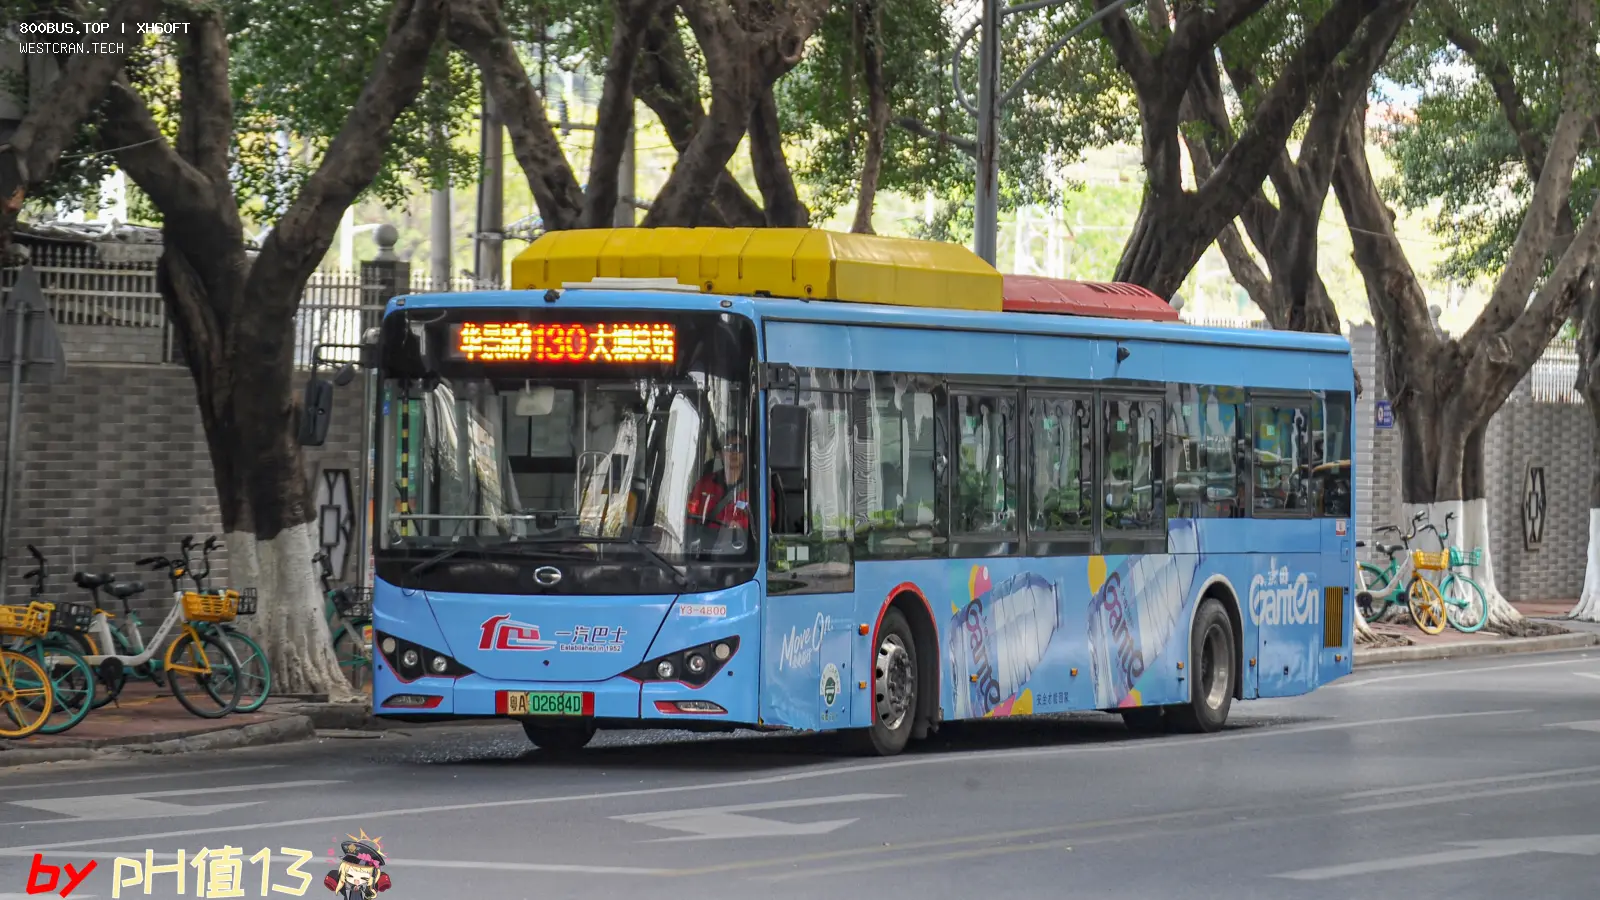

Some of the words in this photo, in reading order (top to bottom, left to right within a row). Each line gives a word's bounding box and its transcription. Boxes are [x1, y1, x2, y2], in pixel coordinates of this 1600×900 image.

[533, 323, 588, 361] 130
[680, 604, 727, 616] Y3-4800
[555, 625, 627, 644] 一汽巴士
[560, 644, 597, 652] Established
[779, 625, 811, 671] Move
[531, 694, 582, 712] 02684D
